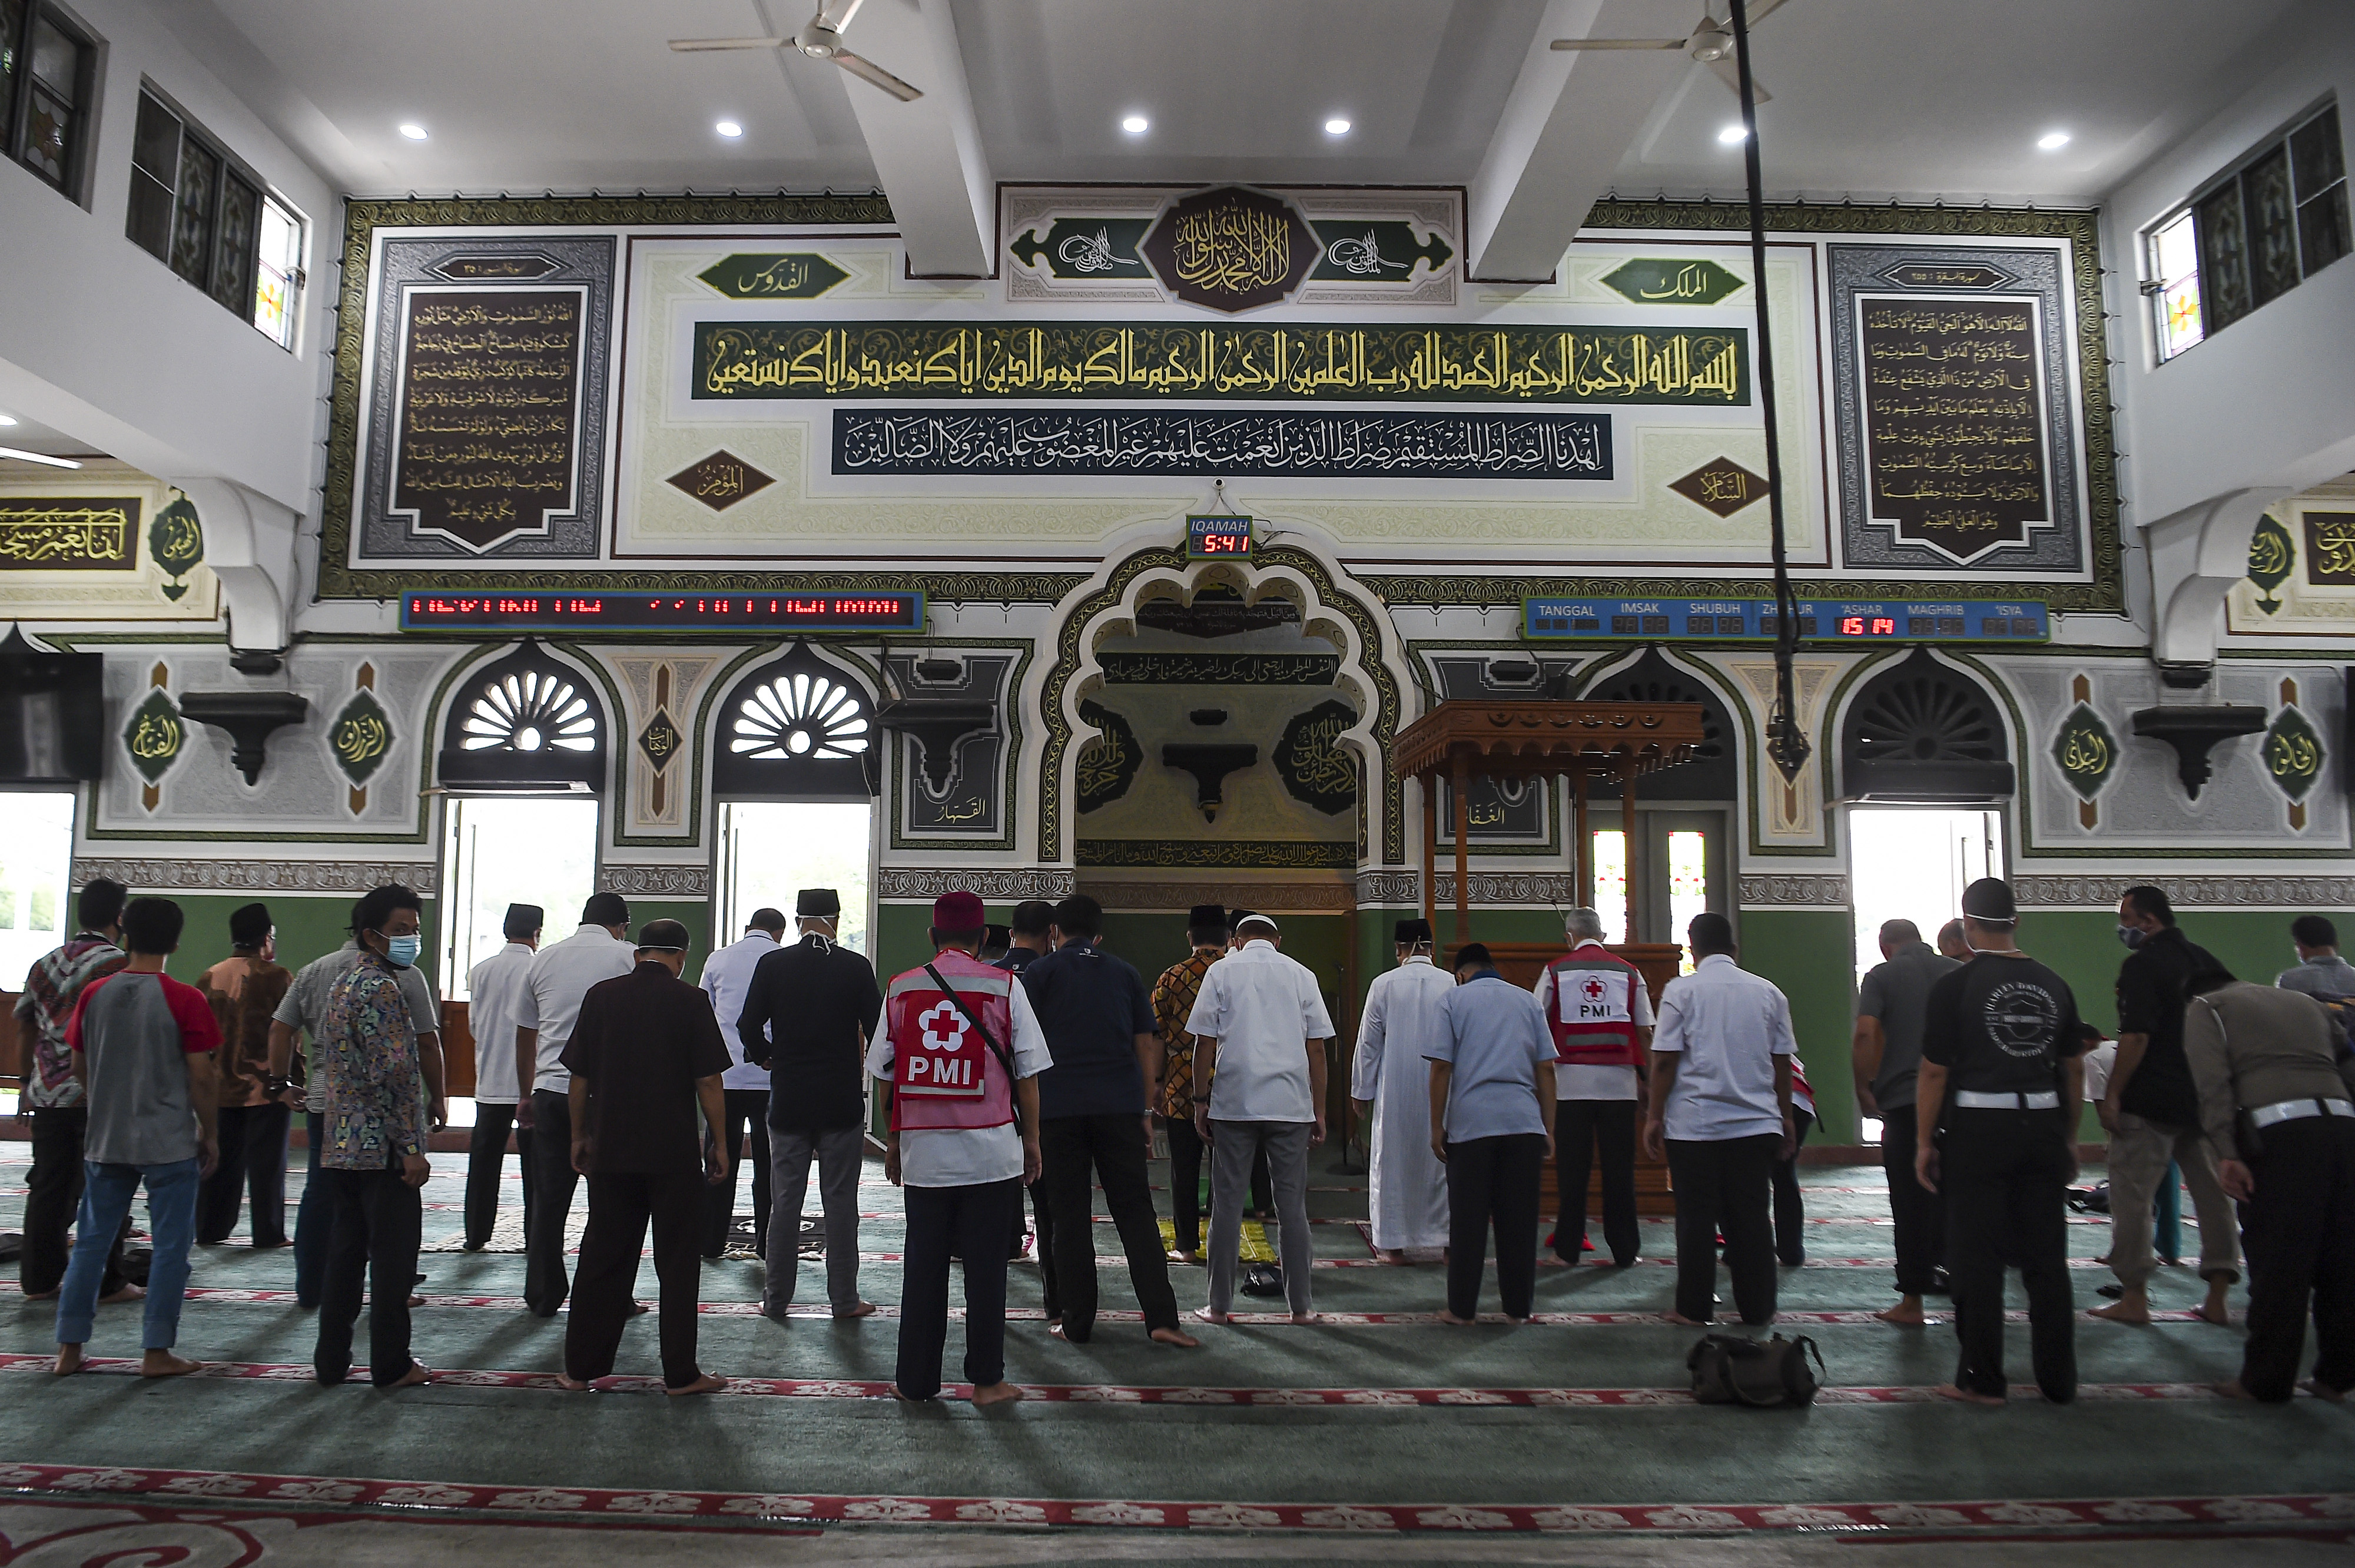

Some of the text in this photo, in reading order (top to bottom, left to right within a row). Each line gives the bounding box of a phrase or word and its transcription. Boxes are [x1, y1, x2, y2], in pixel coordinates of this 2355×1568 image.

[1191, 521, 1248, 532] IQAMAH
[1205, 535, 1248, 552] 5:41
[1538, 605, 1596, 616] TANGGAL
[1621, 603, 1660, 613] IMSAK
[1690, 603, 1741, 614] SHUBUH
[1762, 604, 1813, 614] ZHHUR
[1908, 605, 1964, 615] MAGHRIB
[1580, 1005, 1611, 1017] PMI
[907, 1056, 971, 1085] PMI
